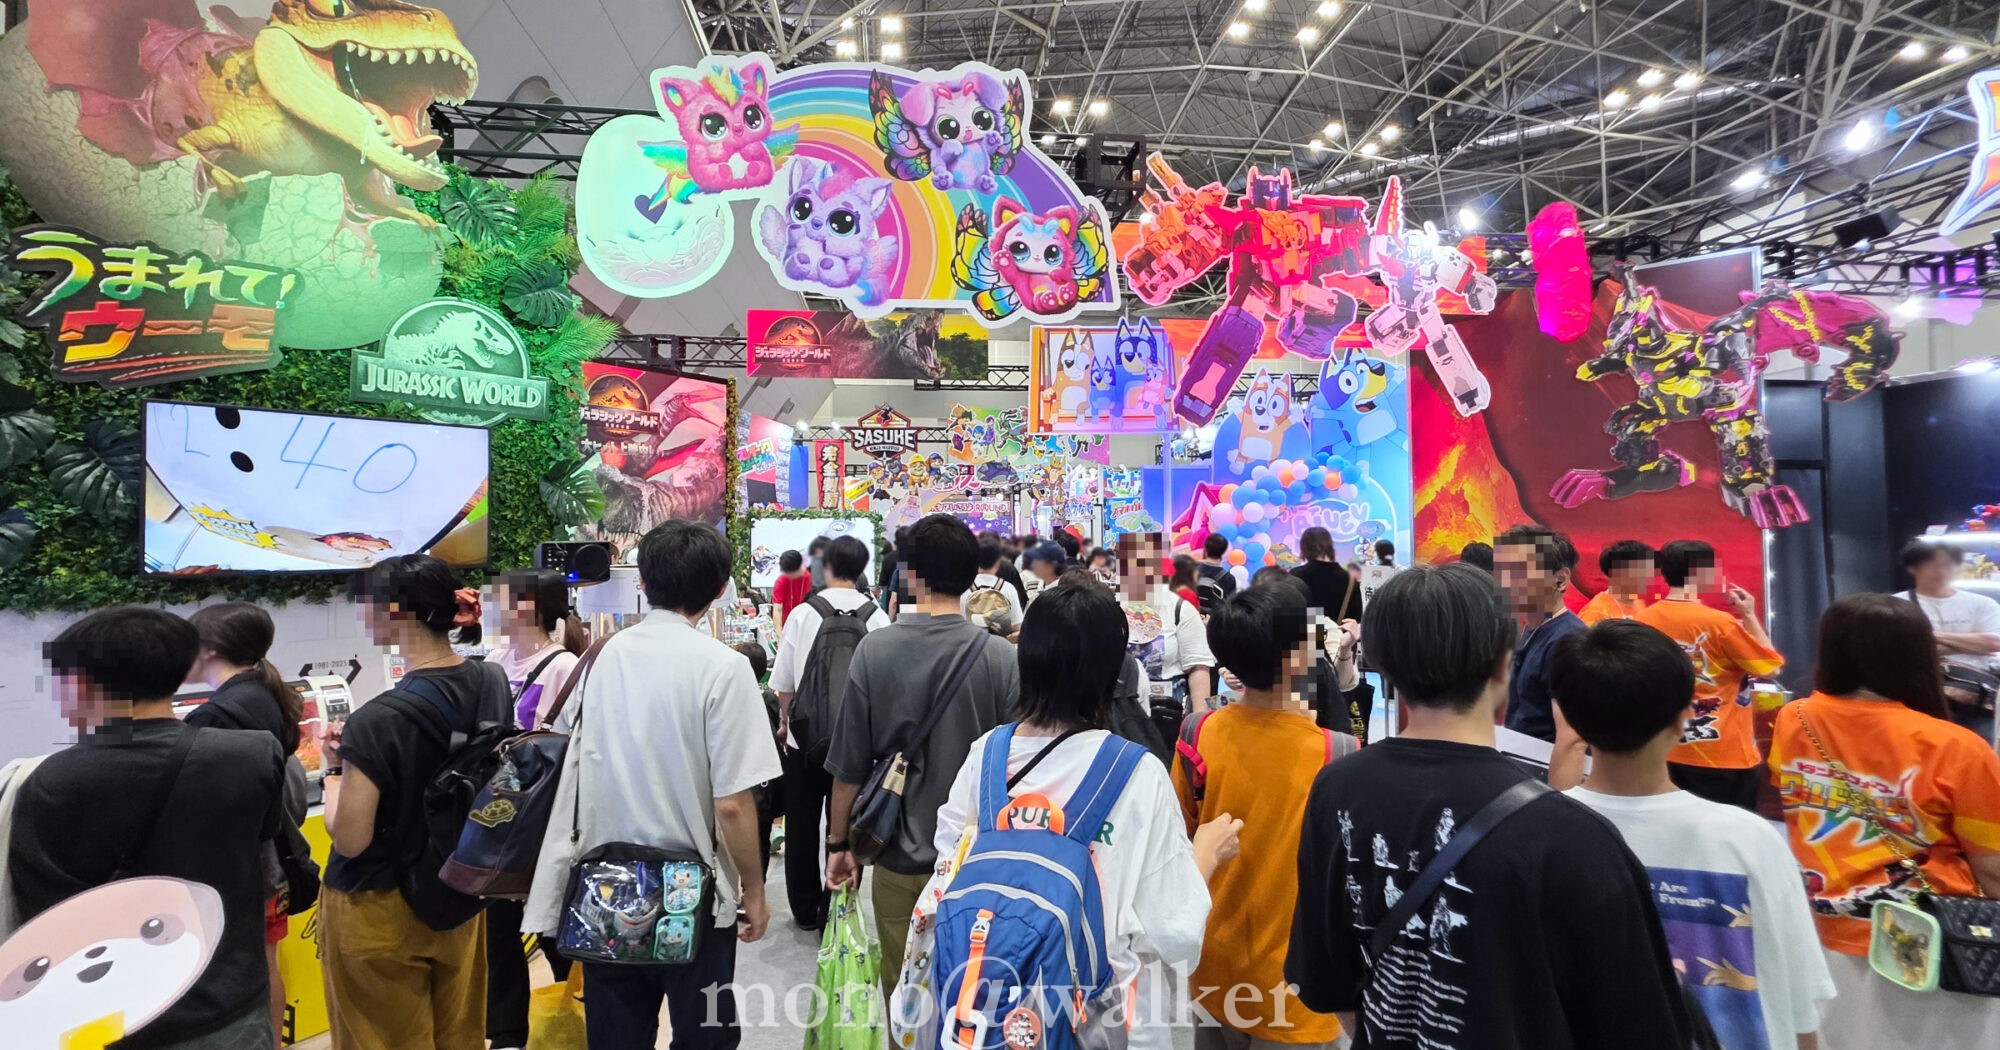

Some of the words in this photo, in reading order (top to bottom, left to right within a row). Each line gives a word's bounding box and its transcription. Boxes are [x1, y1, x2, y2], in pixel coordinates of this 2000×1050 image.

[16, 230, 297, 318] うまれて!
[58, 301, 276, 363] ウーモ
[361, 363, 458, 399] JURASSIC
[460, 377, 542, 409] WORLD
[851, 429, 918, 449] SASUKE
